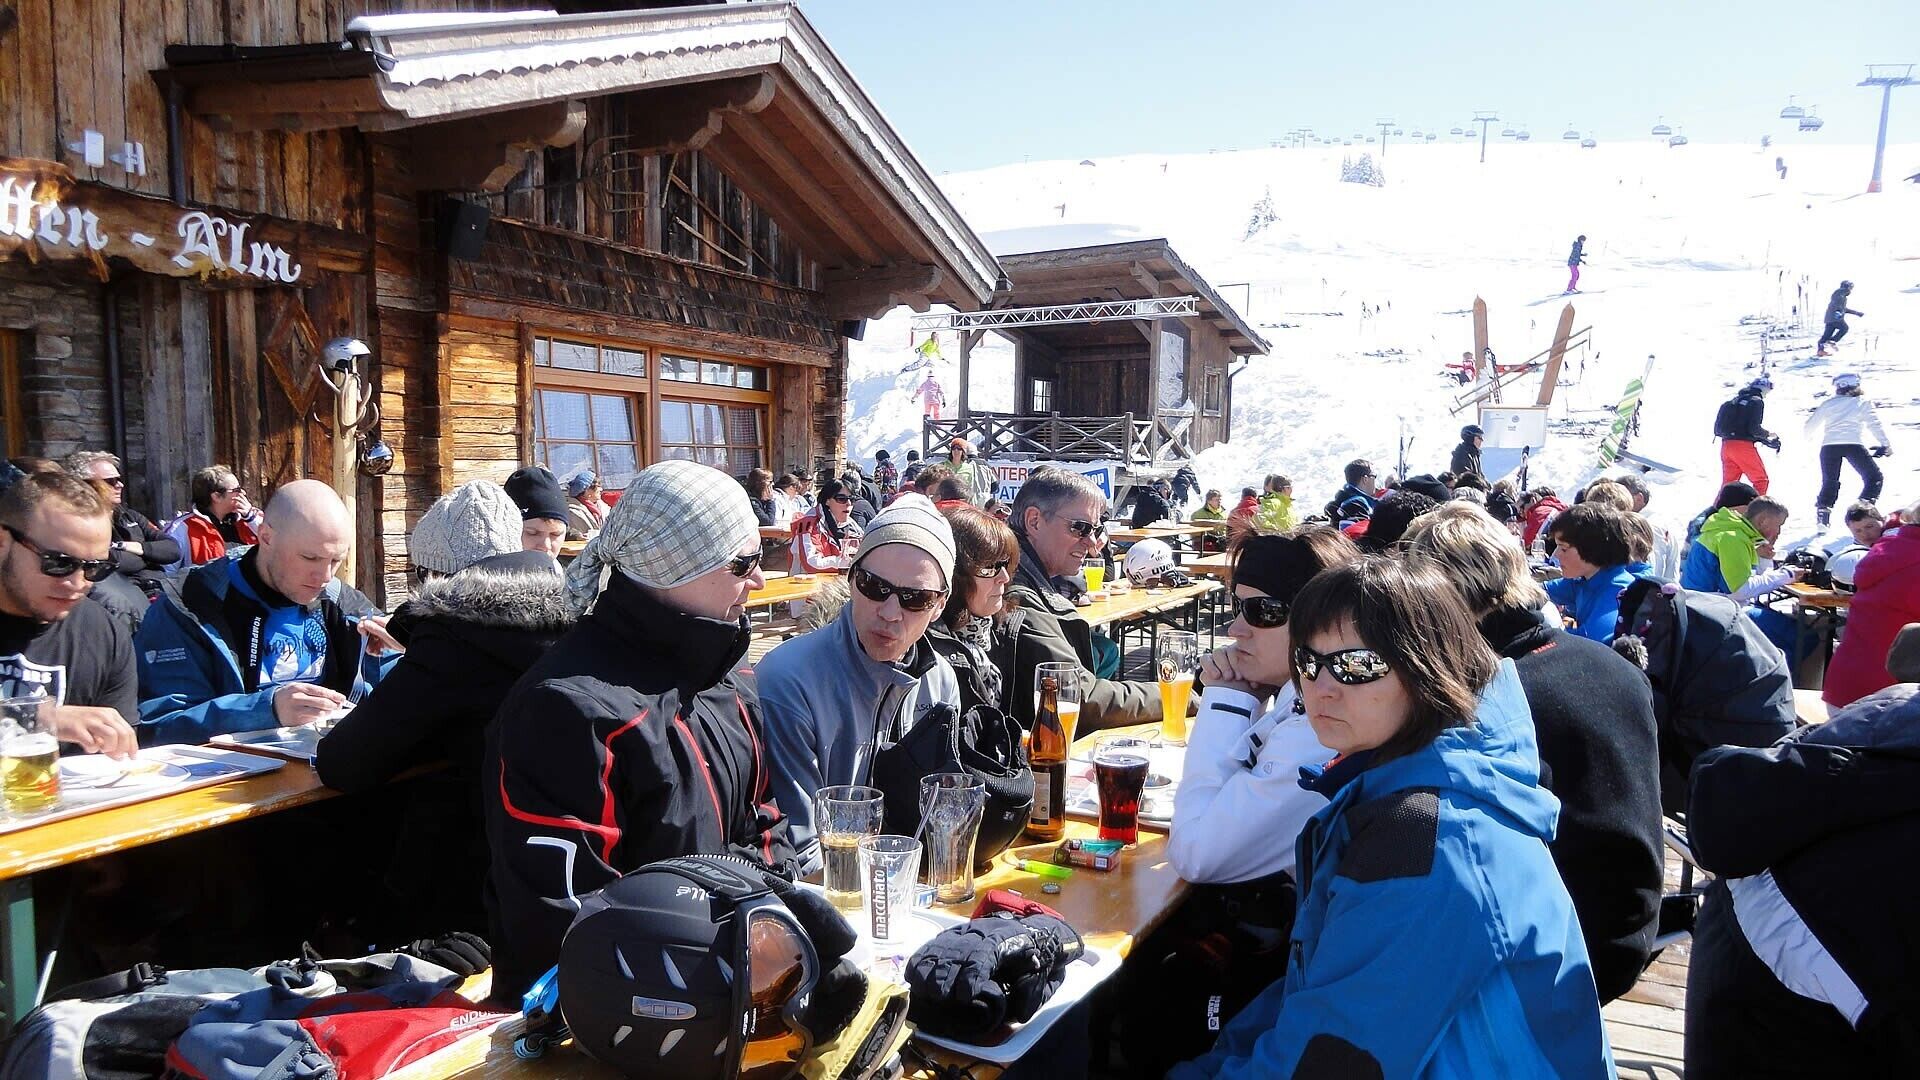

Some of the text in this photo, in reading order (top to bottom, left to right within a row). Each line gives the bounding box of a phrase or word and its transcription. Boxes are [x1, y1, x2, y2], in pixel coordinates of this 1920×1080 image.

[172, 212, 302, 282] Alm
[249, 616, 262, 667] KOMPERDELL
[873, 869, 887, 937] macchiato
